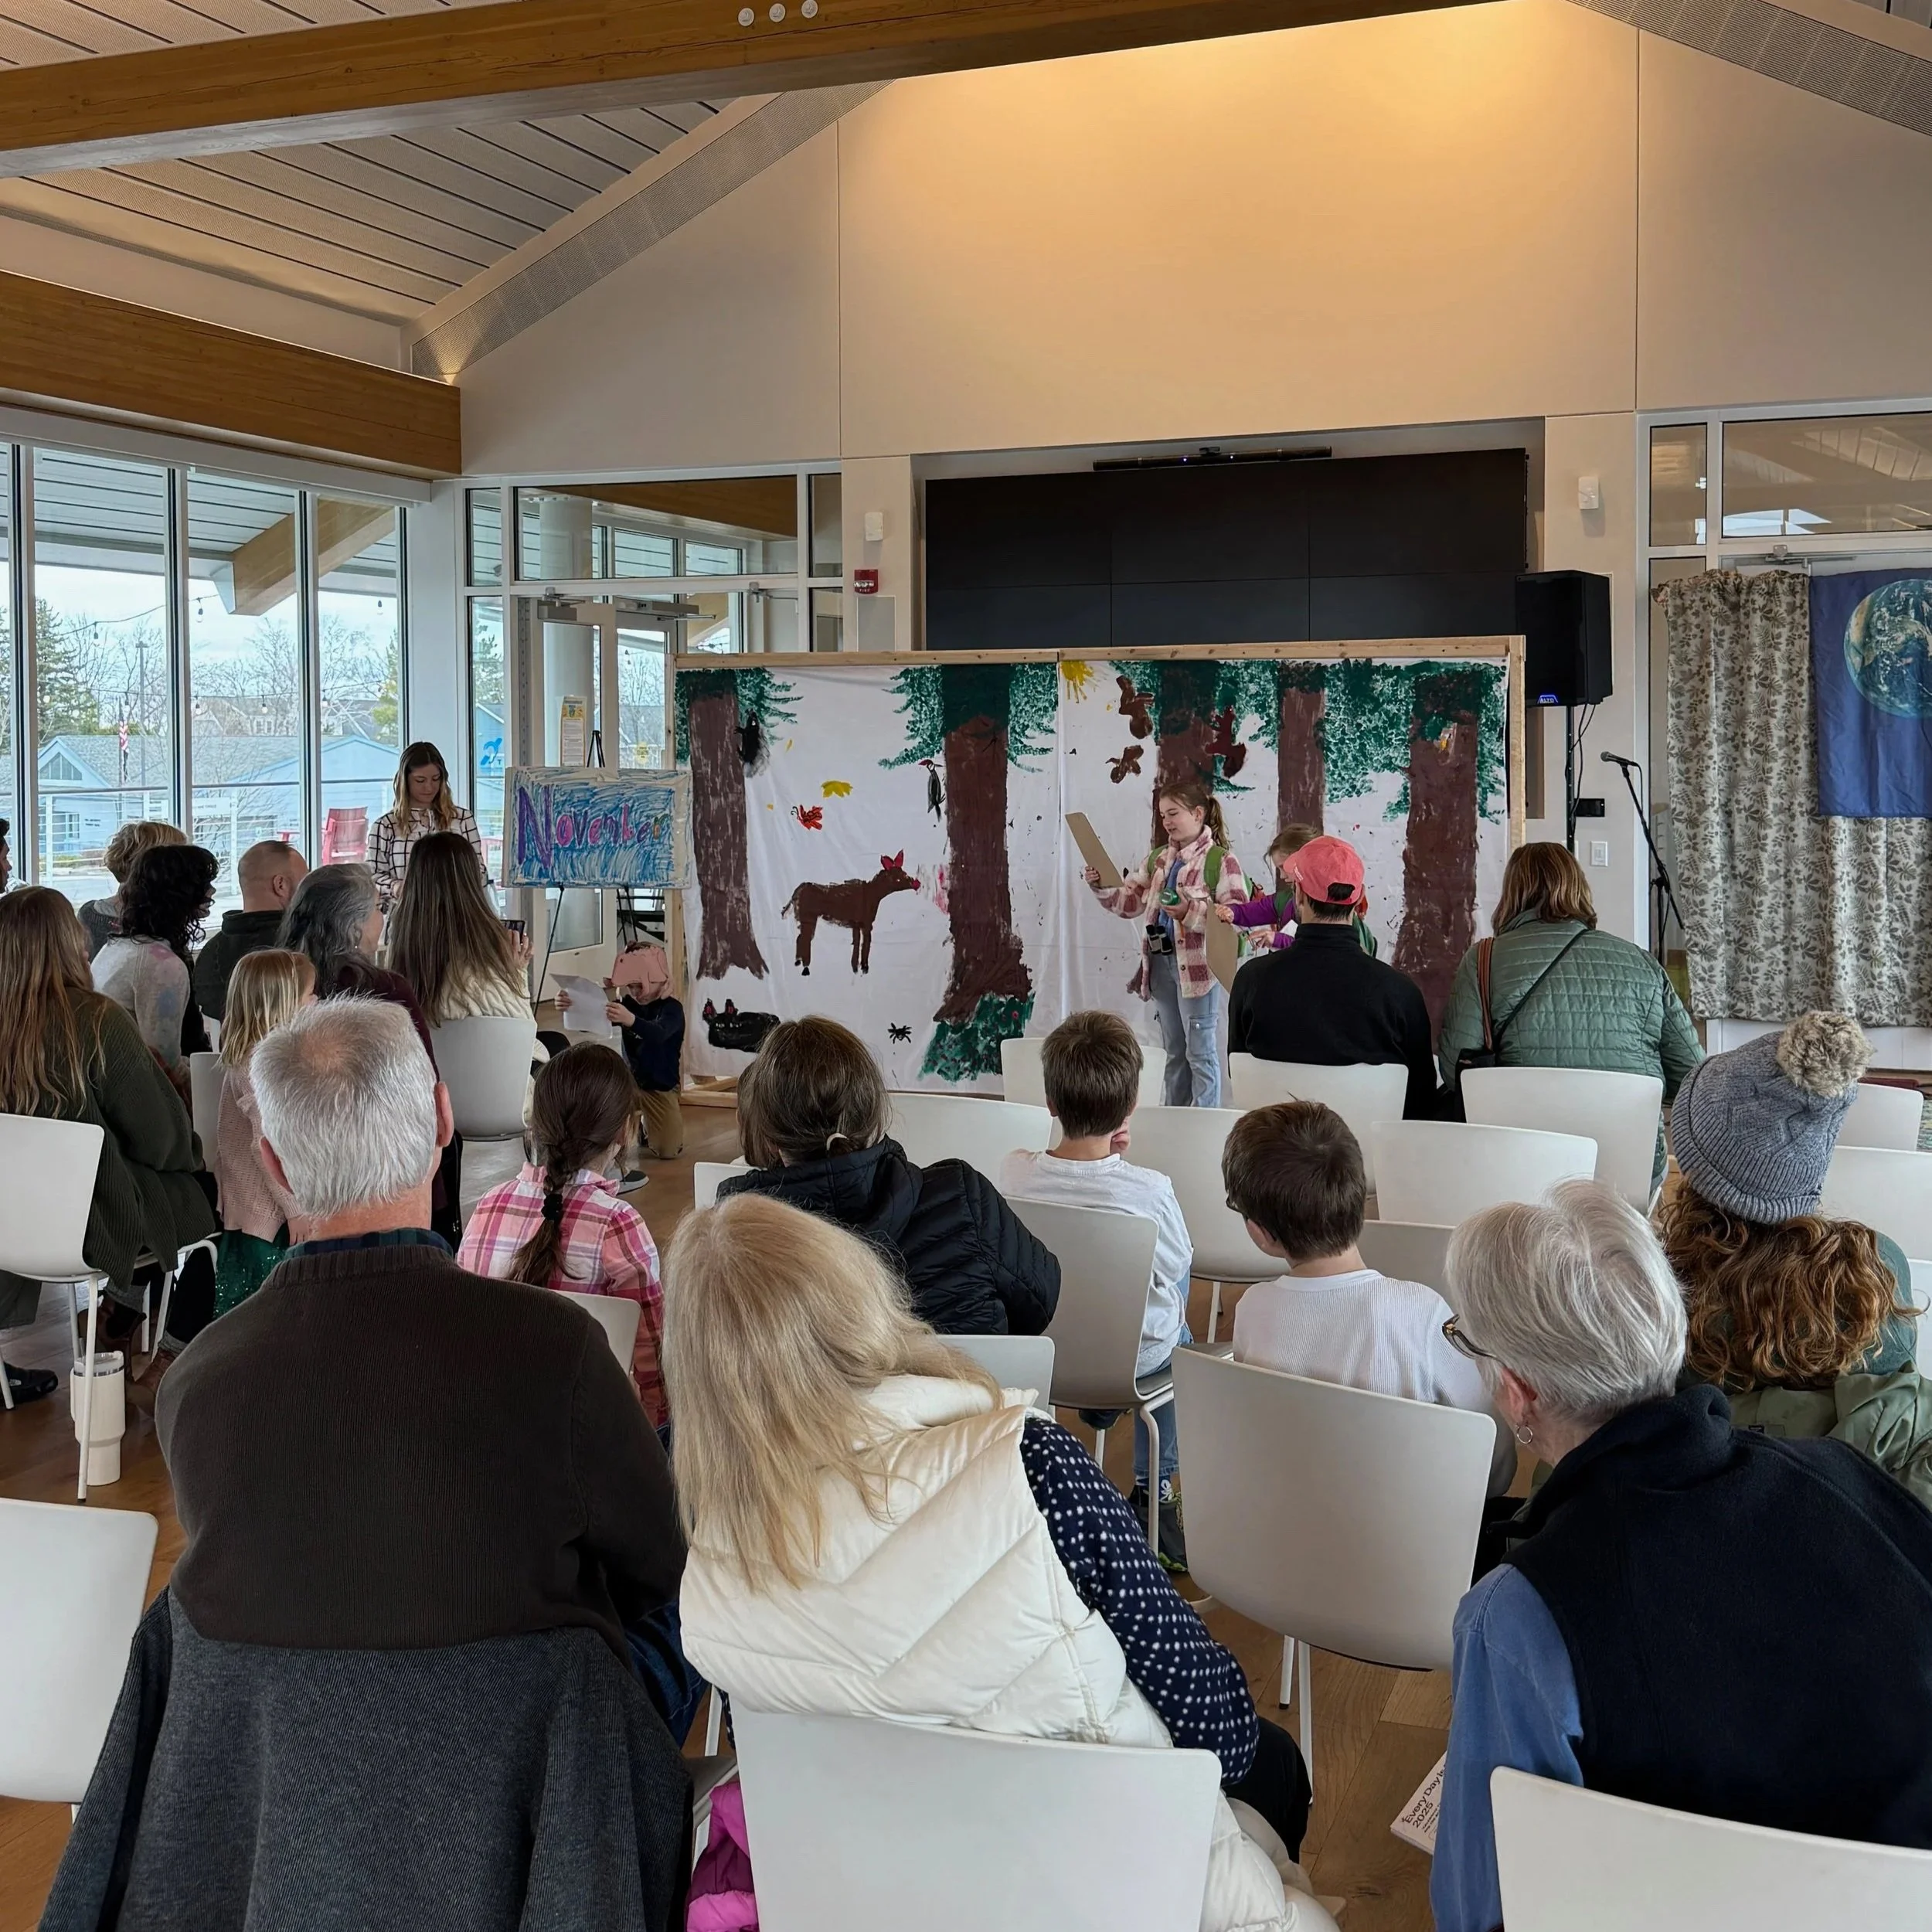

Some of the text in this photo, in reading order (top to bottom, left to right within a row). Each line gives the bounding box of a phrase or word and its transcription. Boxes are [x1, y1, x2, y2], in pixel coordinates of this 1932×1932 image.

[1405, 1796, 1427, 1824] Every
[1423, 1777, 1440, 1796] Day
[1413, 1801, 1434, 1828] 2025
